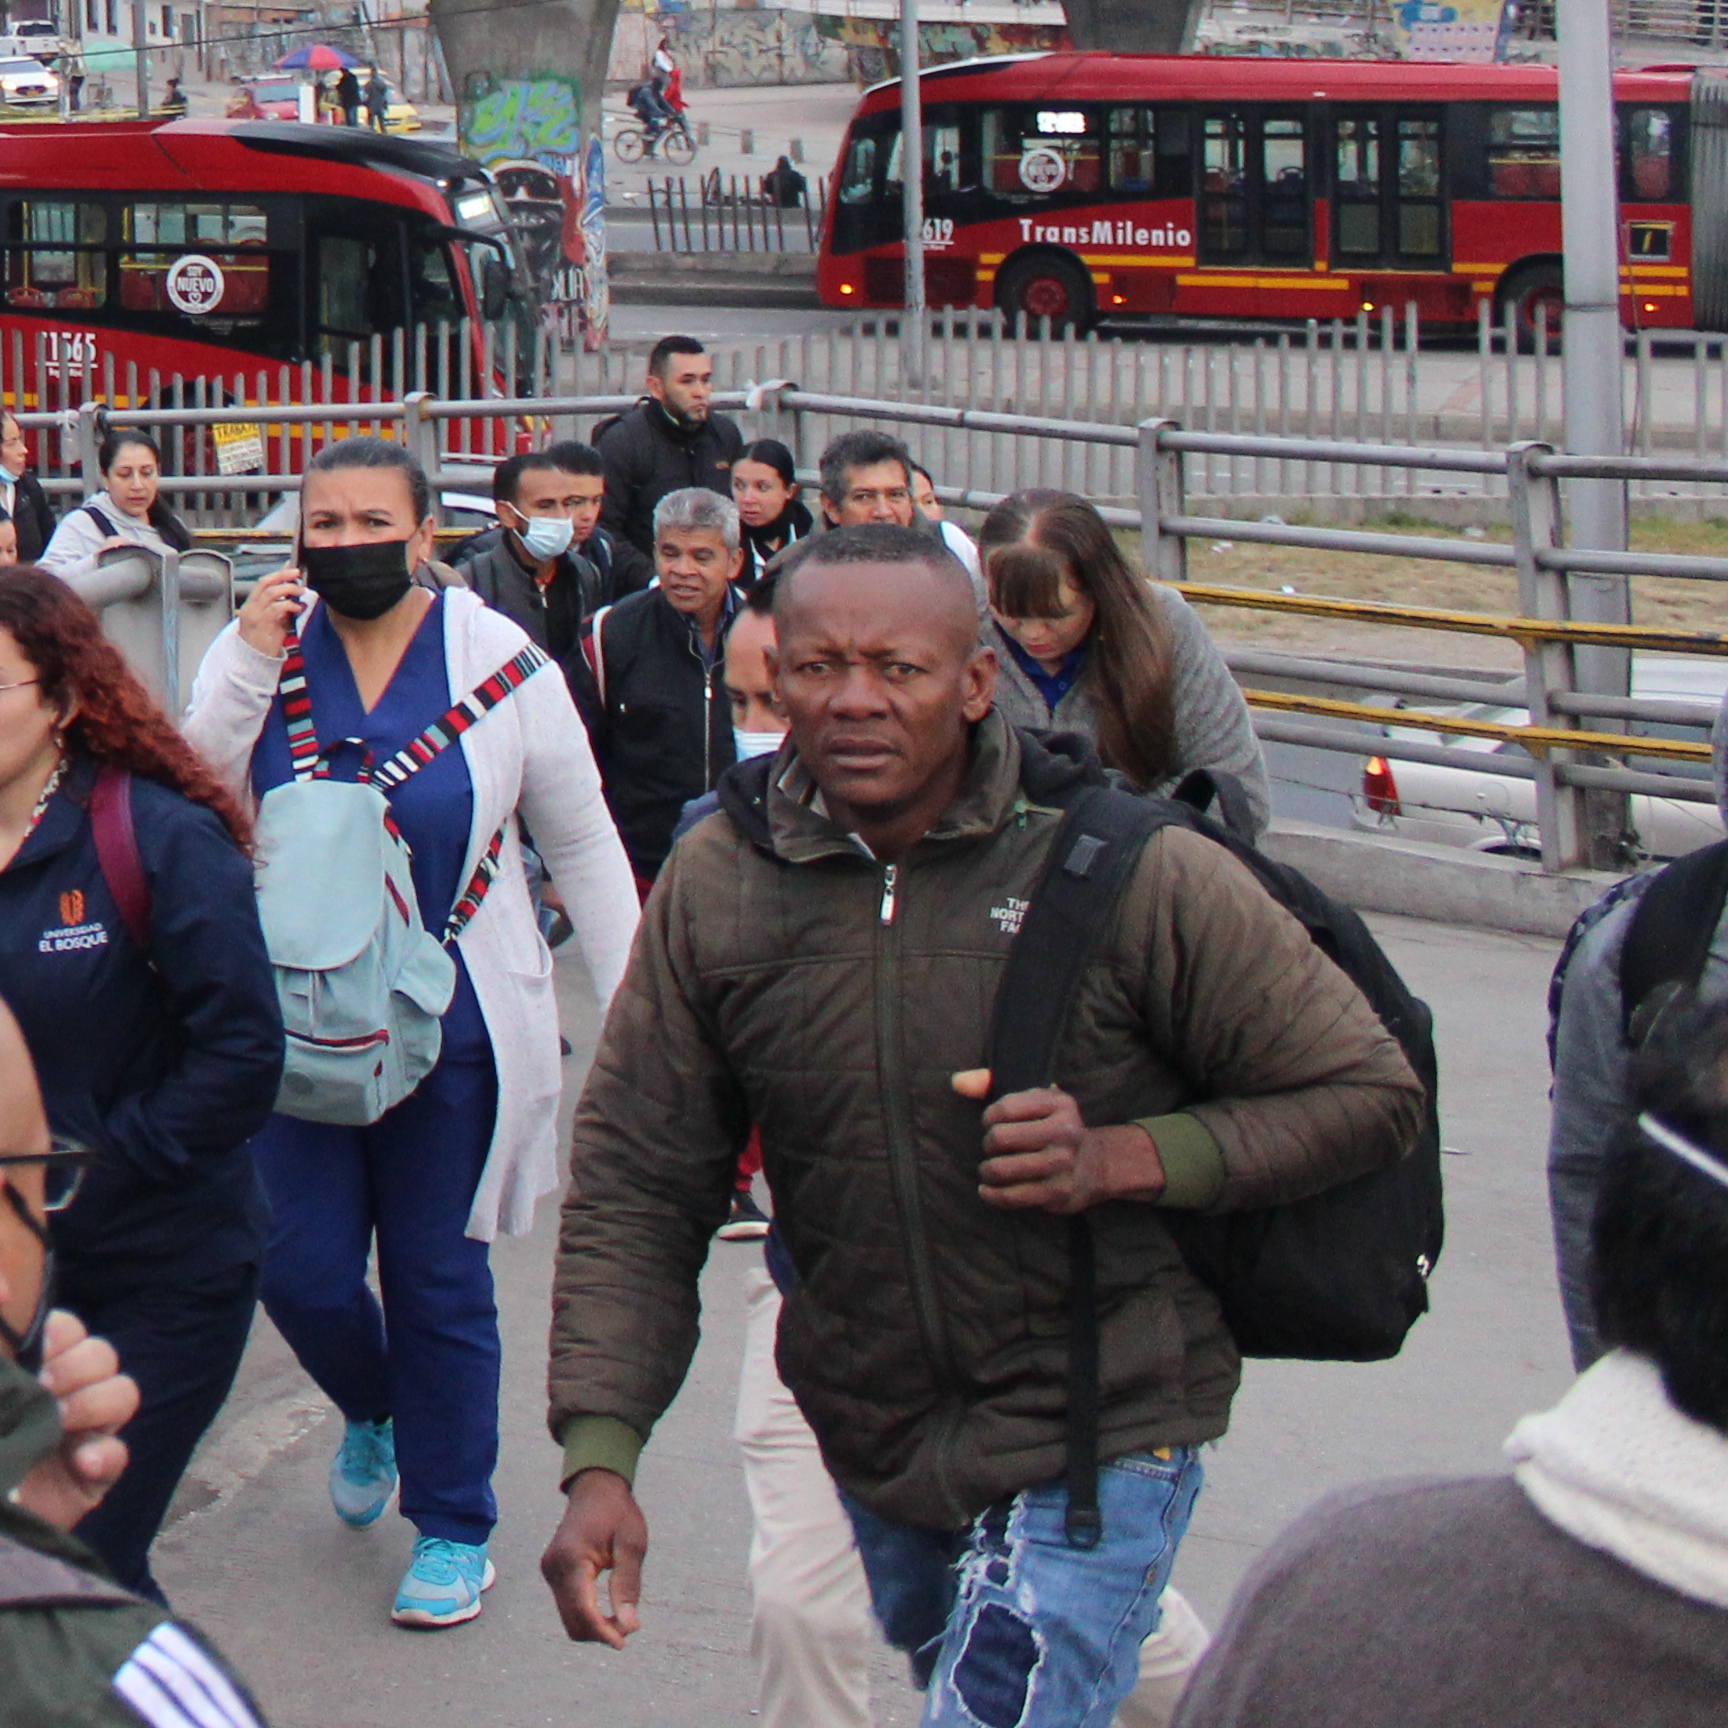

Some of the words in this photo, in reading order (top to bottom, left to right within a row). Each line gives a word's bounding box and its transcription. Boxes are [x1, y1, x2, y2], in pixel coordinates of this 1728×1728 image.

[1018, 218, 1192, 247] TransMilenio
[177, 277, 214, 292] NUEVO
[43, 922, 103, 939] UNIVERSIDAD
[38, 940, 54, 952] EL
[55, 931, 108, 950] BOSQUE
